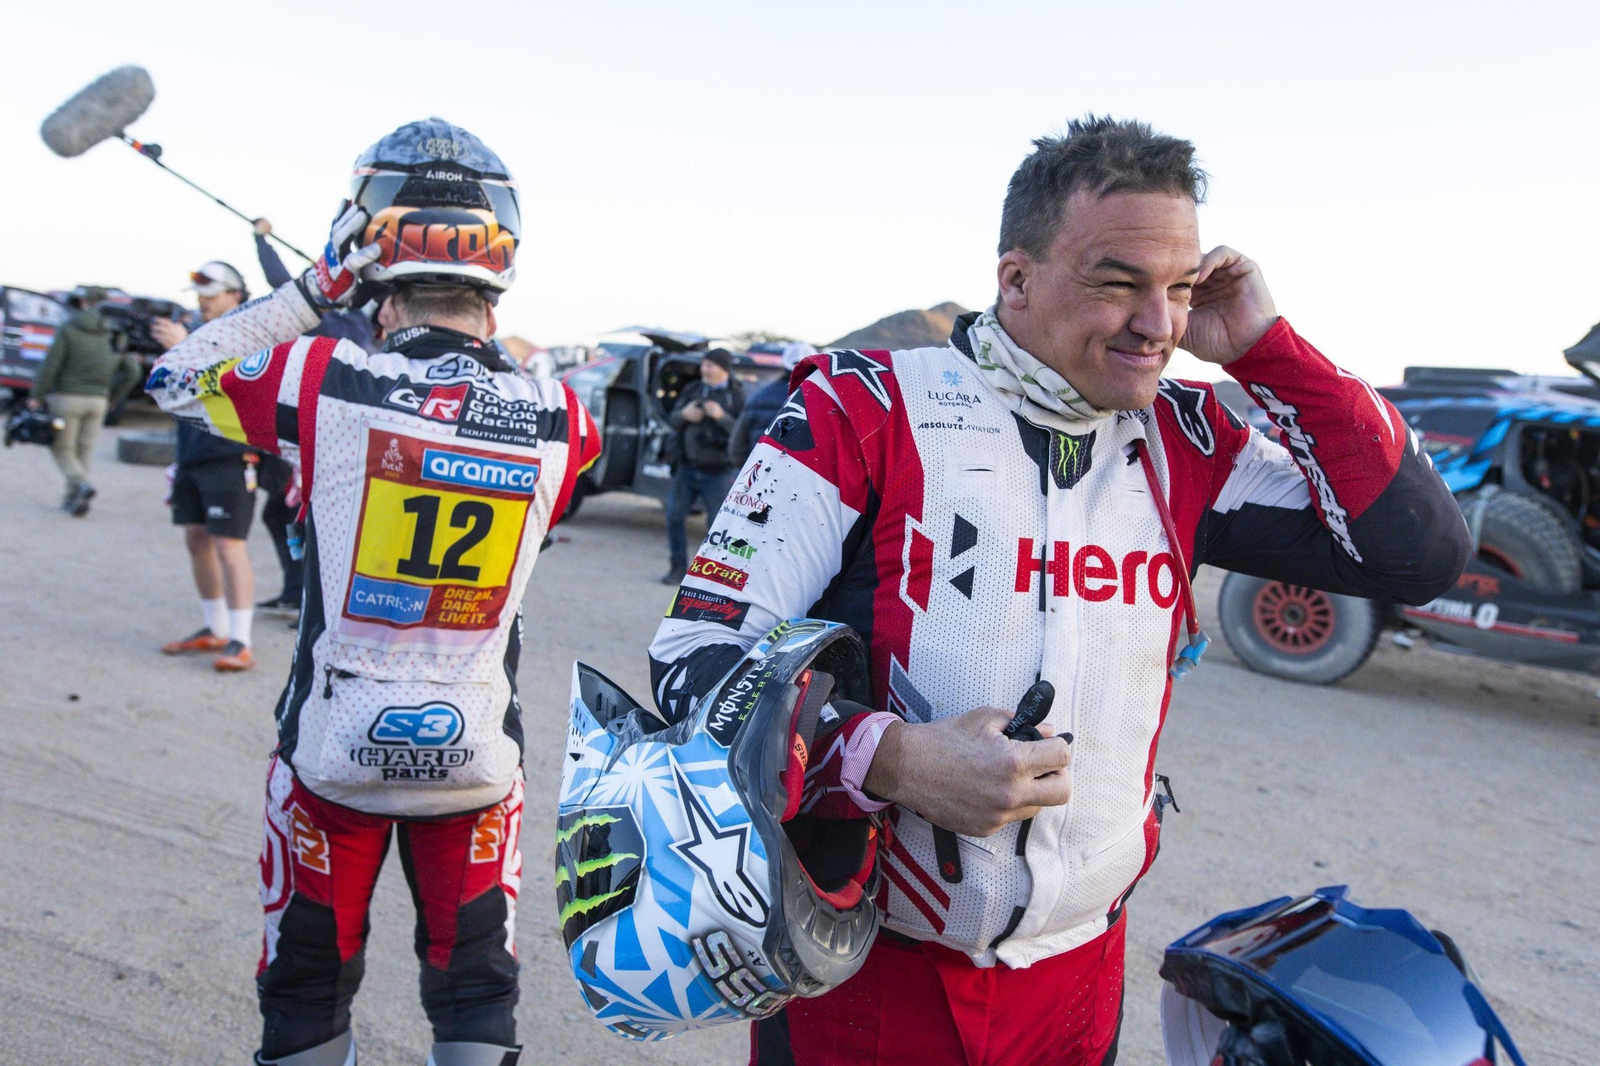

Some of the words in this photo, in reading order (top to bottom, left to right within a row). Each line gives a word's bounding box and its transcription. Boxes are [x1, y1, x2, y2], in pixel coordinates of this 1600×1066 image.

[426, 169, 463, 182] AIROH
[472, 388, 538, 412] TOYOTA
[927, 390, 982, 404] LUCARA
[469, 399, 538, 422] GAZOO
[465, 411, 538, 435] Racing
[917, 421, 964, 431] ABSOLUTE
[963, 424, 1001, 434] AVIATION
[460, 427, 499, 440] SOUTH
[500, 434, 536, 445] AFRICA
[430, 457, 535, 488] aramco
[396, 494, 494, 582] 12
[701, 561, 744, 583] Craft
[1014, 537, 1180, 610] Hero
[438, 611, 470, 621] LIVE
[441, 600, 480, 612] DARE.
[738, 663, 779, 722] ENERGY
[357, 747, 468, 768] HARD
[381, 765, 449, 781] parts
